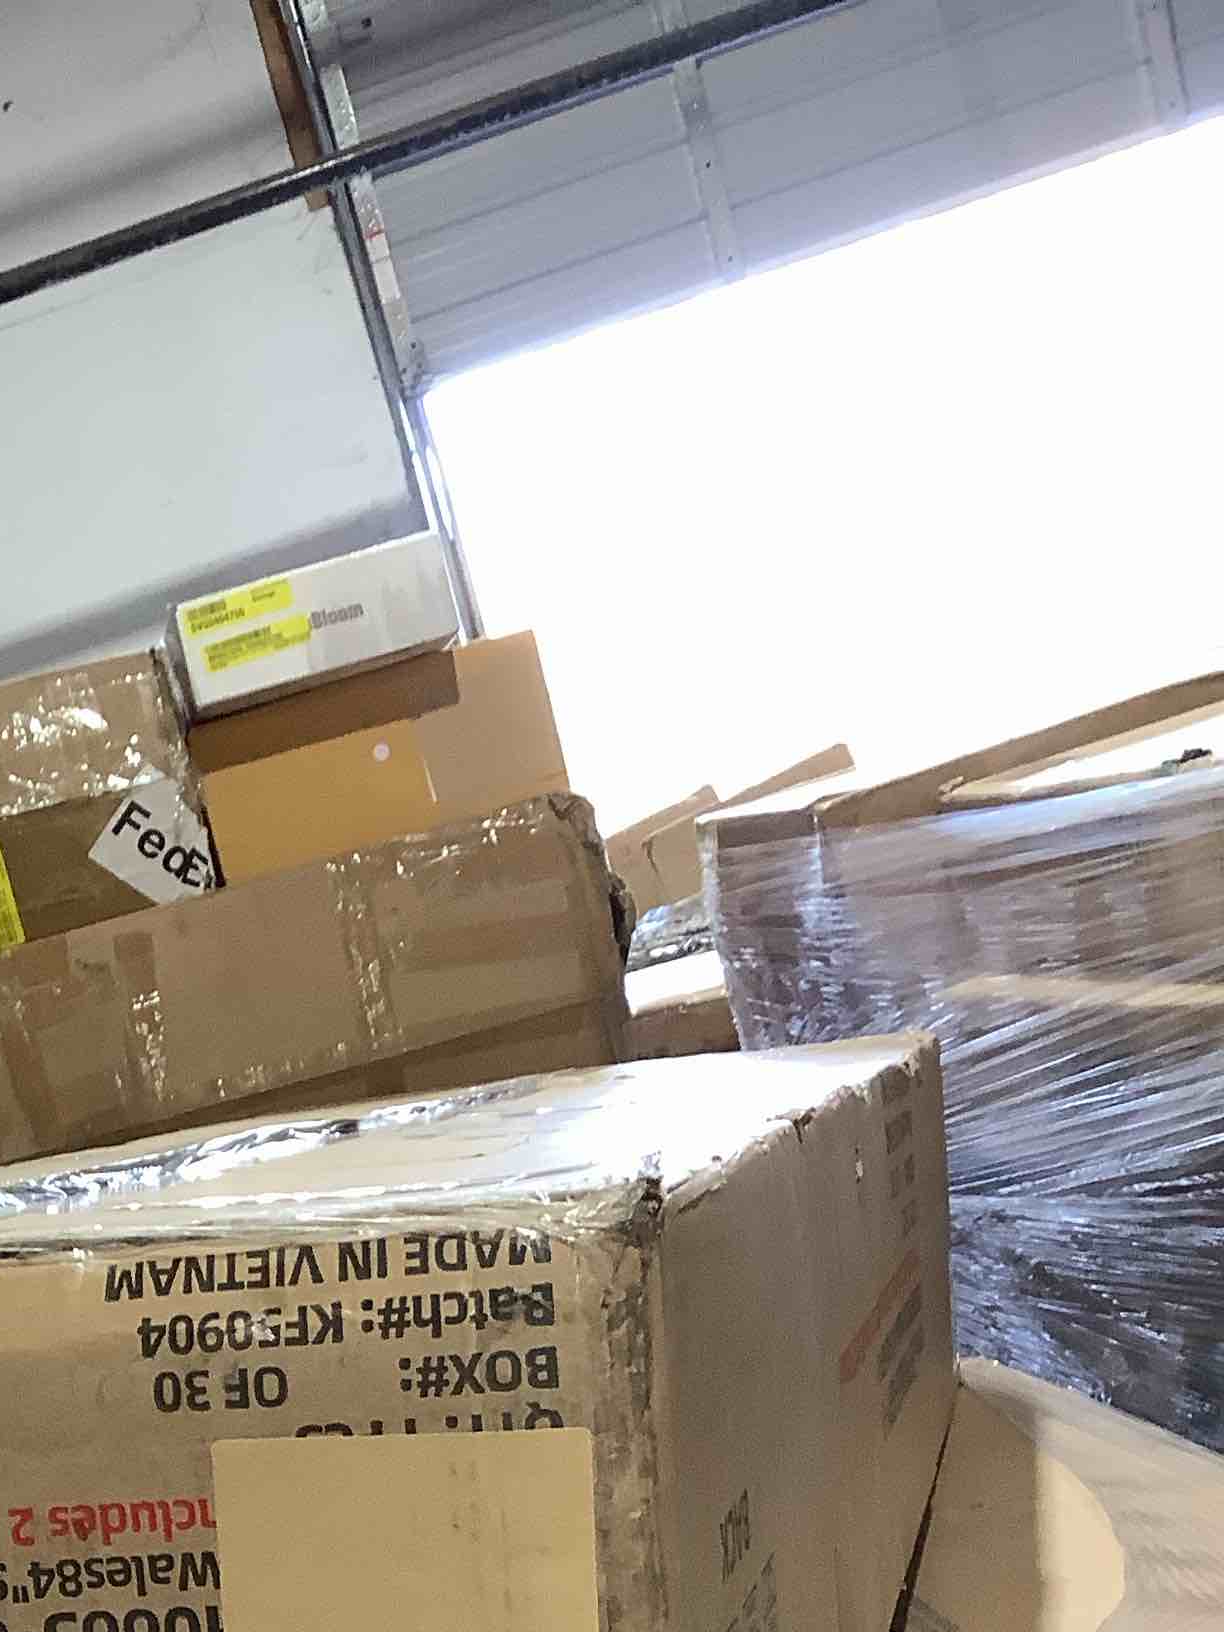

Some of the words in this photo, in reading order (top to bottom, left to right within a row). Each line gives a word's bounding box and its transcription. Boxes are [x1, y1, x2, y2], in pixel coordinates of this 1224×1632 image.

[112, 800, 214, 889] FedE
[104, 1245, 326, 1302] VIETNAM
[337, 1237, 388, 1283] IN
[404, 1228, 553, 1277] MADE
[360, 1281, 555, 1340] Batch#:
[152, 1368, 212, 1413] 30
[224, 1365, 289, 1411] OF
[398, 1344, 560, 1399] BOX#:
[7, 1506, 36, 1547] 2
